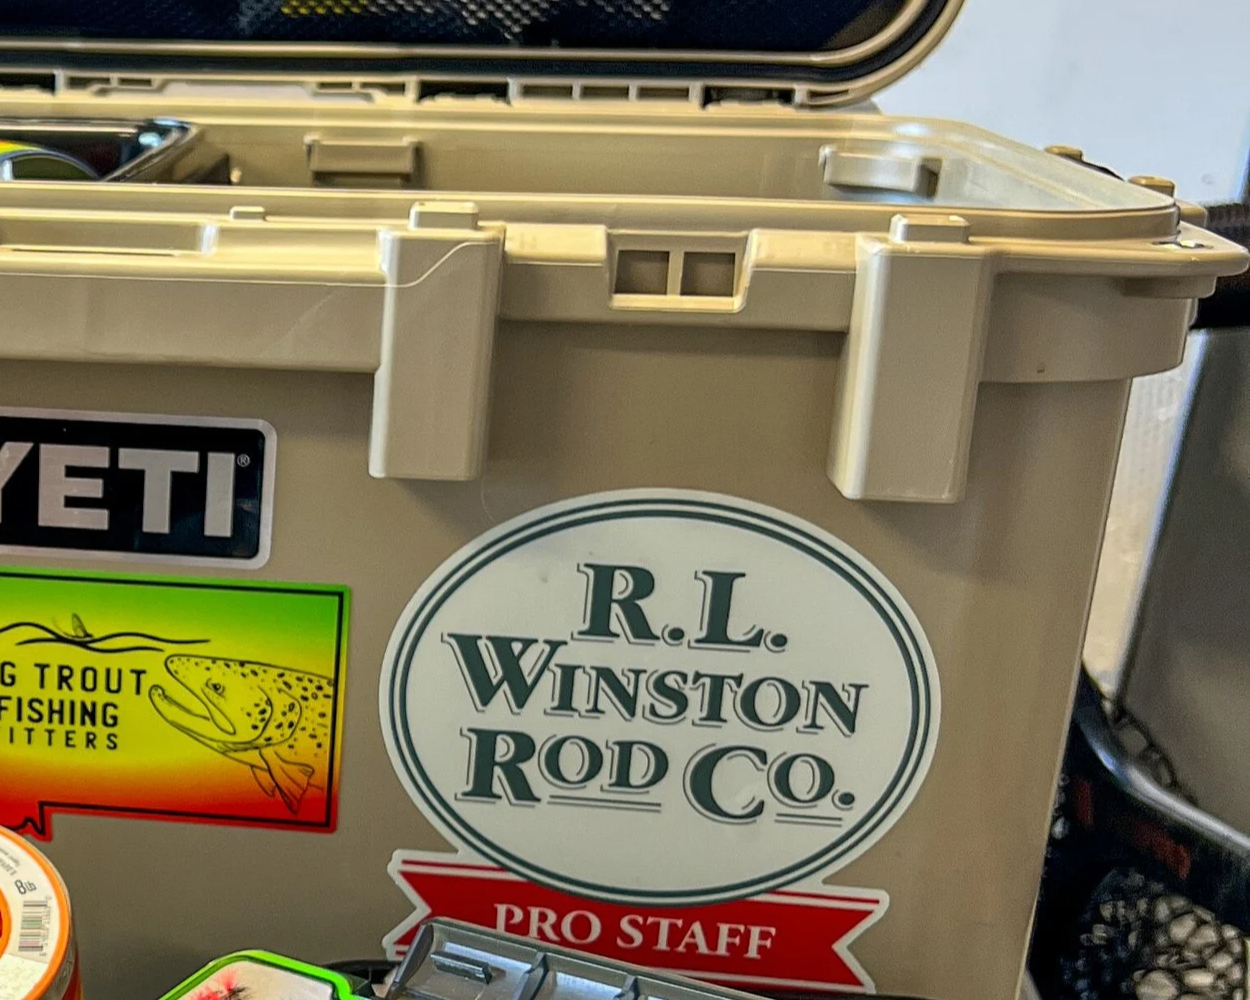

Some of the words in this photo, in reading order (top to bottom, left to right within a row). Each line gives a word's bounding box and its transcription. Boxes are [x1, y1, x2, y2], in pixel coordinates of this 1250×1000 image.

[570, 562, 789, 654] R.L.
[33, 662, 147, 696] TROUT
[441, 631, 870, 736] WINSTON
[454, 726, 669, 806] ROD
[683, 743, 856, 826] CO.
[494, 903, 602, 945] PRO
[616, 914, 776, 959] STAFF
